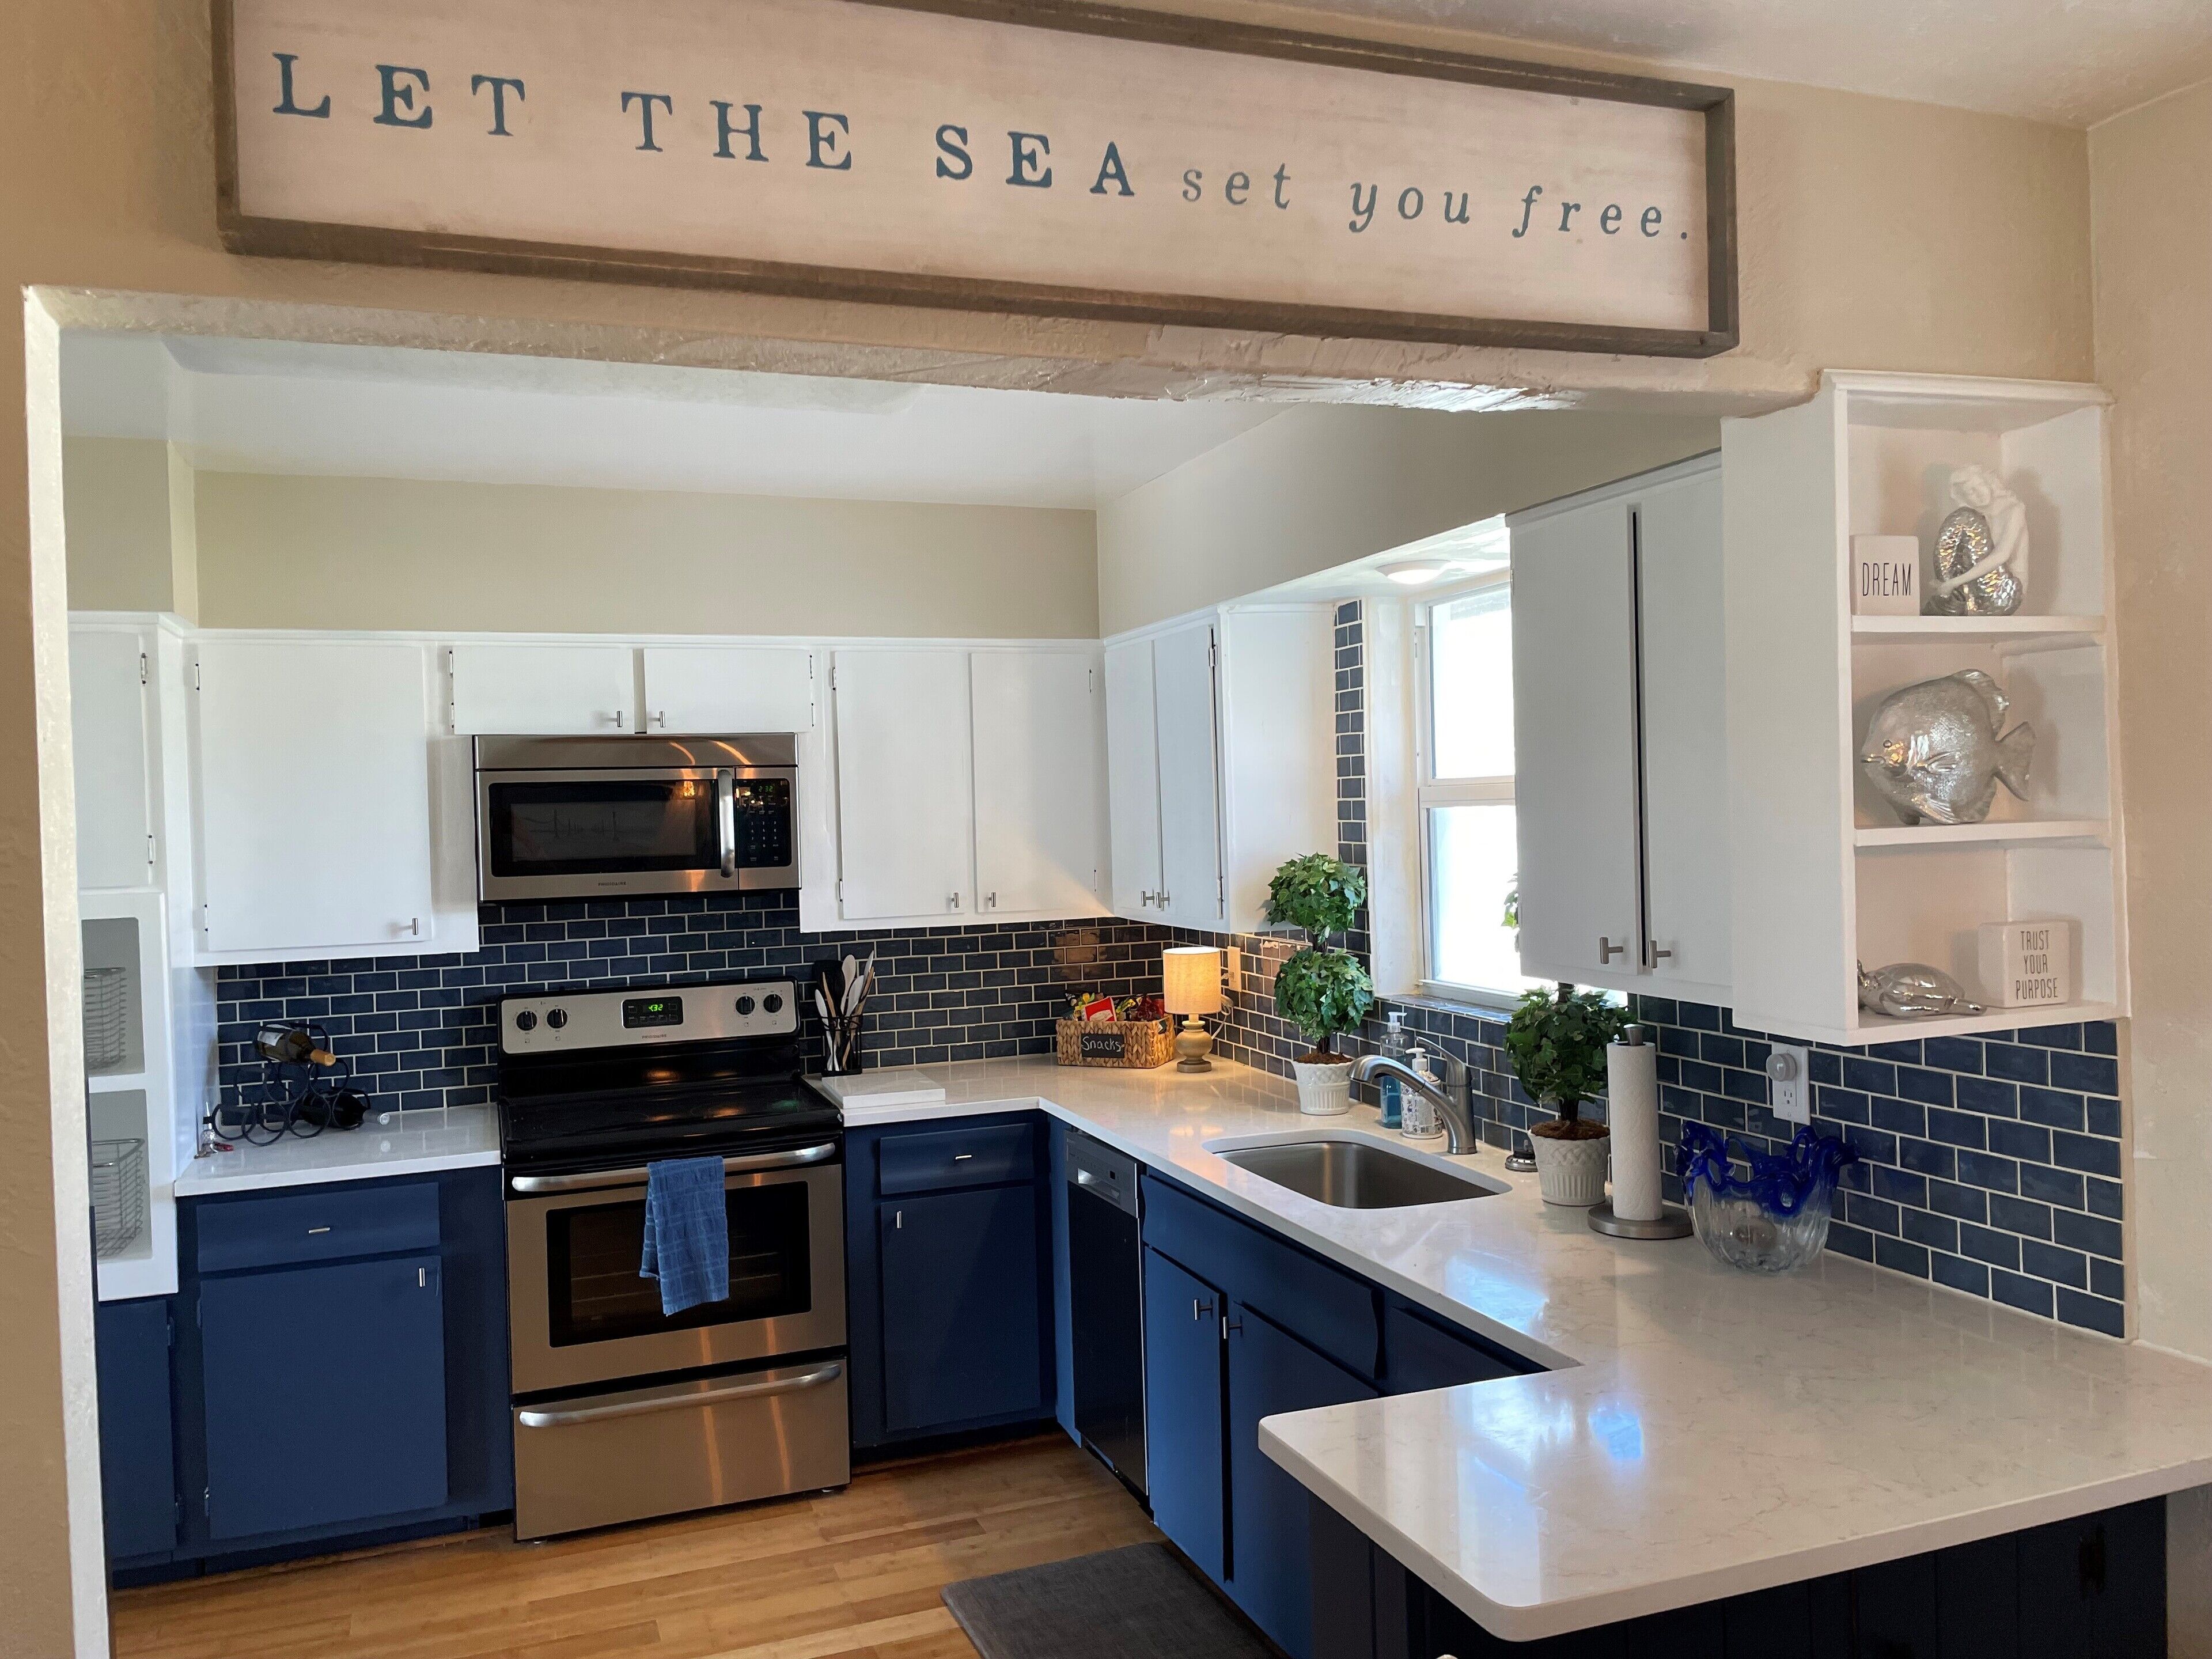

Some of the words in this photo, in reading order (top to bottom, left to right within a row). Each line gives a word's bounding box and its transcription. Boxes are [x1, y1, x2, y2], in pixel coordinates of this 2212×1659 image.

[272, 52, 526, 137] LET
[620, 91, 853, 171] THE
[935, 123, 1135, 197] SEA
[1182, 162, 1292, 210] set
[1348, 181, 1471, 234] you
[1512, 184, 1688, 240] free.
[1862, 562, 1912, 596] DREAM
[2020, 929, 2050, 950] TRUST
[2023, 953, 2048, 975] YOUR
[2015, 977, 2058, 1000] PURPOSE
[1081, 1036, 1122, 1052] Snacks
